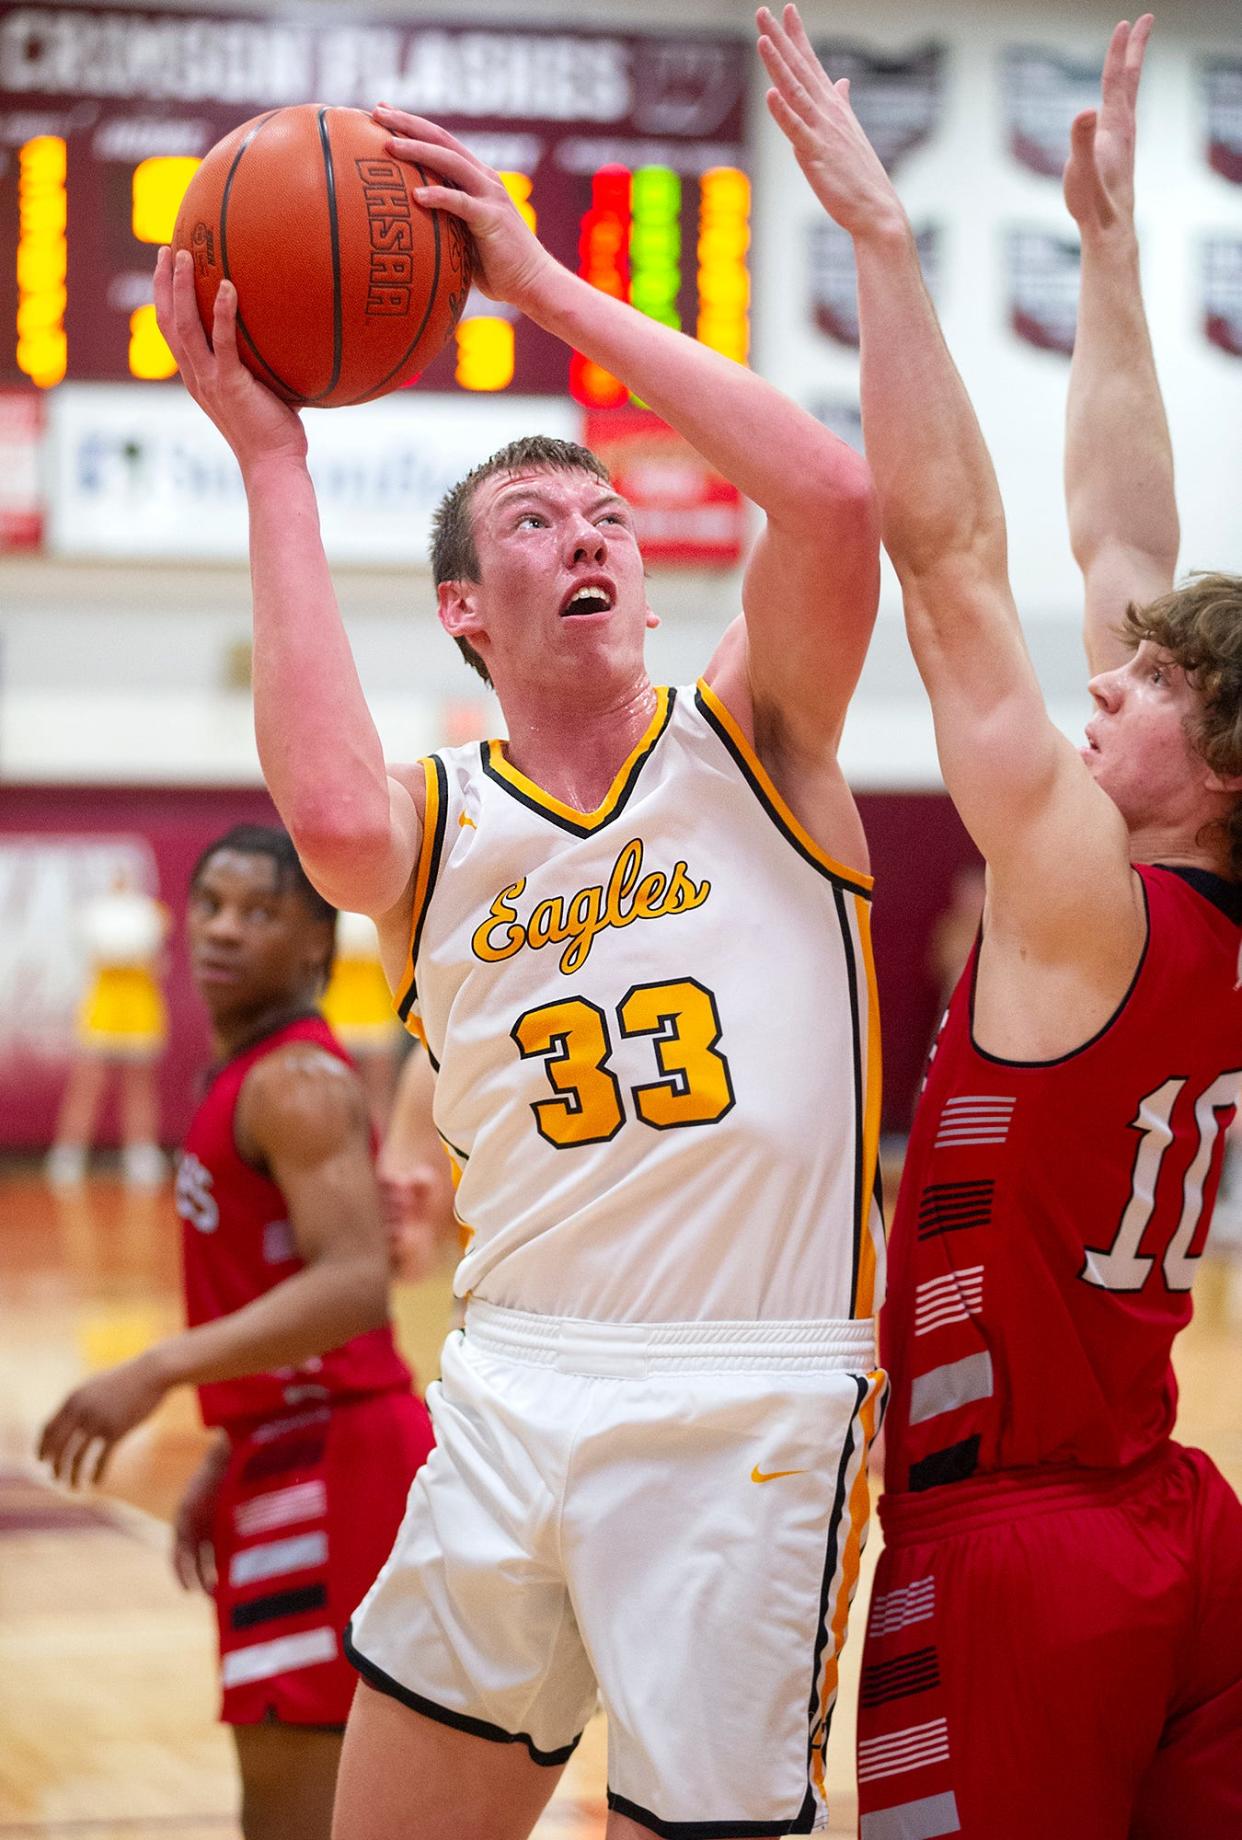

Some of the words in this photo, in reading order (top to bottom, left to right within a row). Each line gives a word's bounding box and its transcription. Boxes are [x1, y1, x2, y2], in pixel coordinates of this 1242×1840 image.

[1, 11, 310, 104] CRIMSON
[317, 26, 632, 122] FLASHES
[355, 158, 413, 317] OHSAA
[471, 837, 712, 976] Eagles
[509, 976, 737, 1150] 33
